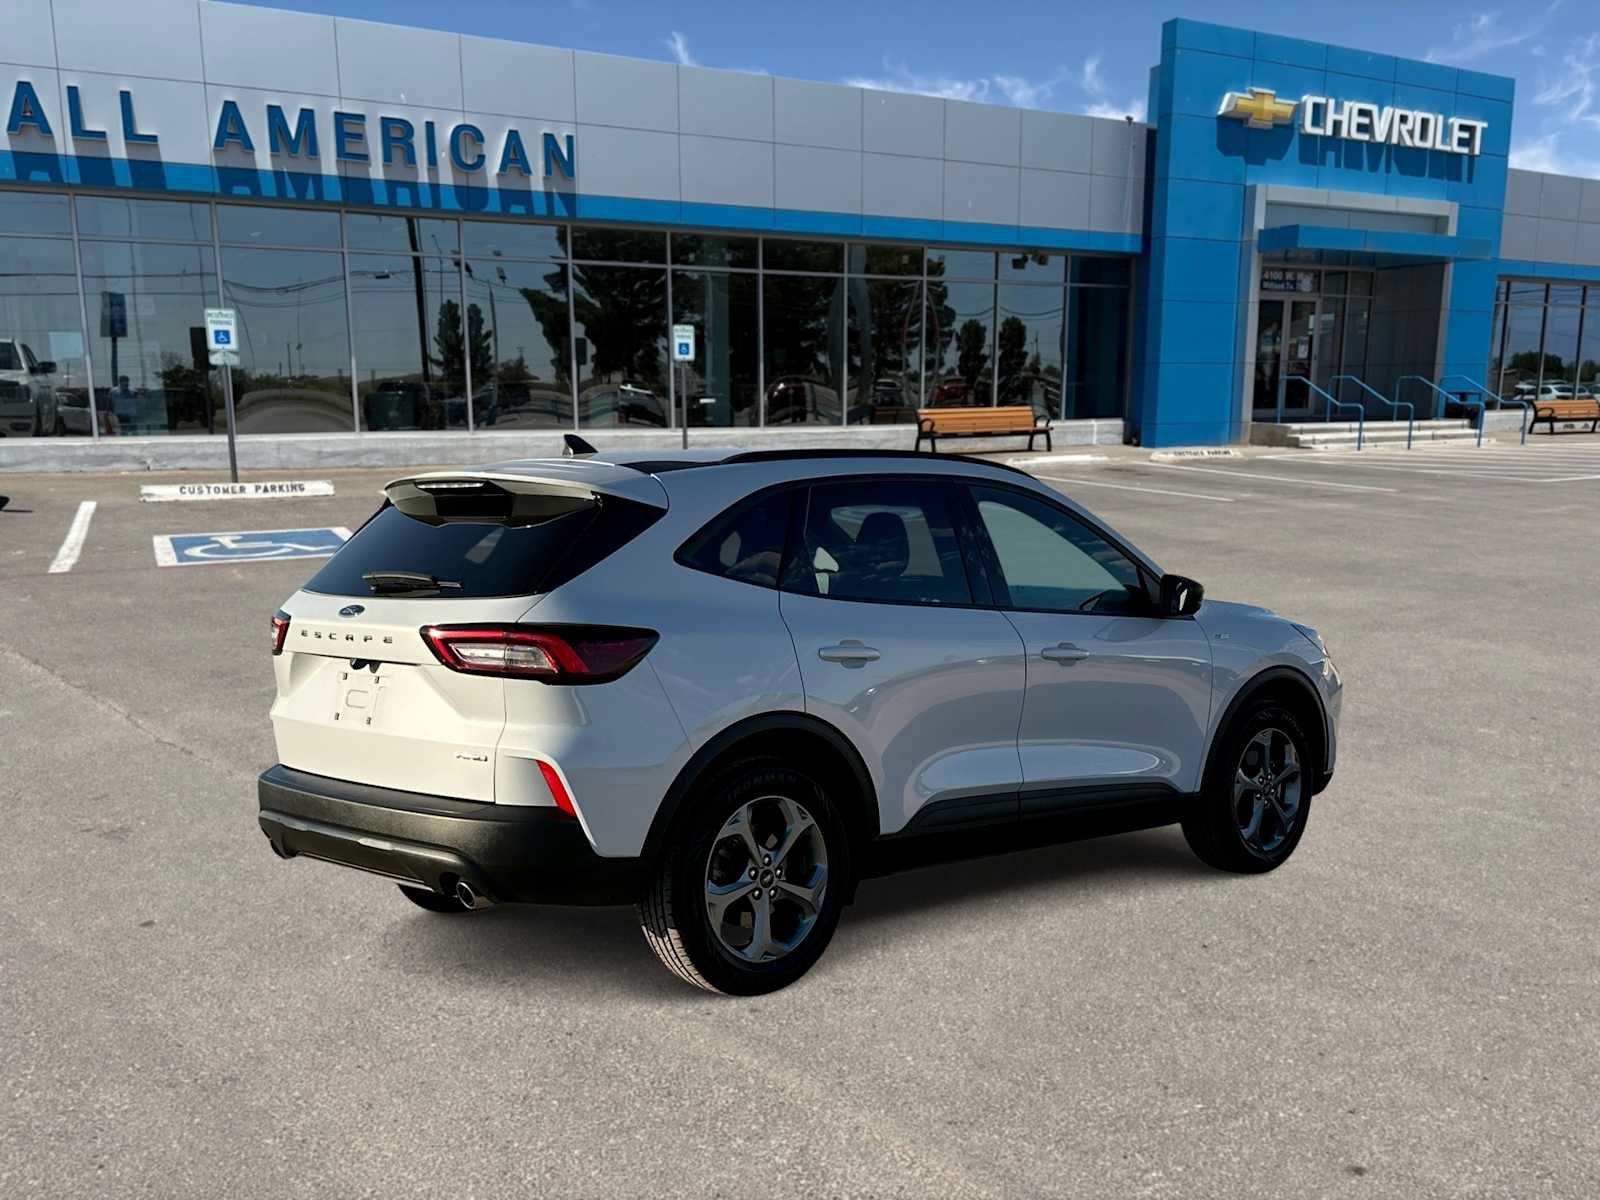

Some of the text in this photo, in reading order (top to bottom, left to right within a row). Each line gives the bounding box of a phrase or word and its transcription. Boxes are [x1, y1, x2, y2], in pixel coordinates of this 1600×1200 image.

[6, 80, 576, 179] ALL AMERICAN
[1301, 94, 1488, 156] CHEVROLET
[179, 483, 306, 495] CUSTOMER PARKING
[300, 629, 394, 645] ESCAPE
